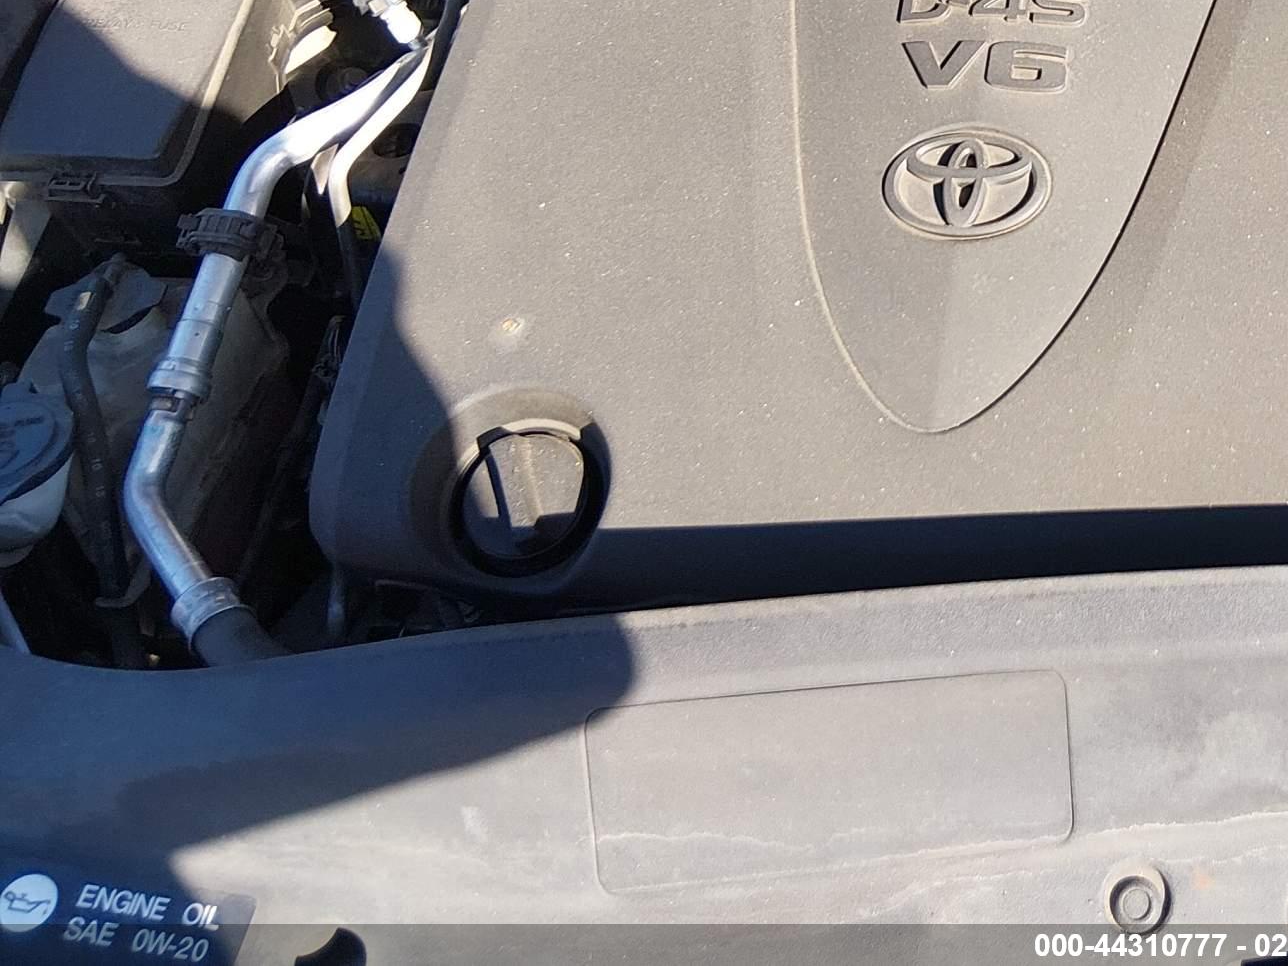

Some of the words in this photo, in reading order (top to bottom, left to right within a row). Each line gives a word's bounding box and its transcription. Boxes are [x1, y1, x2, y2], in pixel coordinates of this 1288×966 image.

[901, 39, 1070, 94] V6
[75, 883, 171, 921] ENGINE
[181, 901, 219, 932] OIL
[63, 915, 119, 947] SAE
[131, 927, 210, 963] 0W-20
